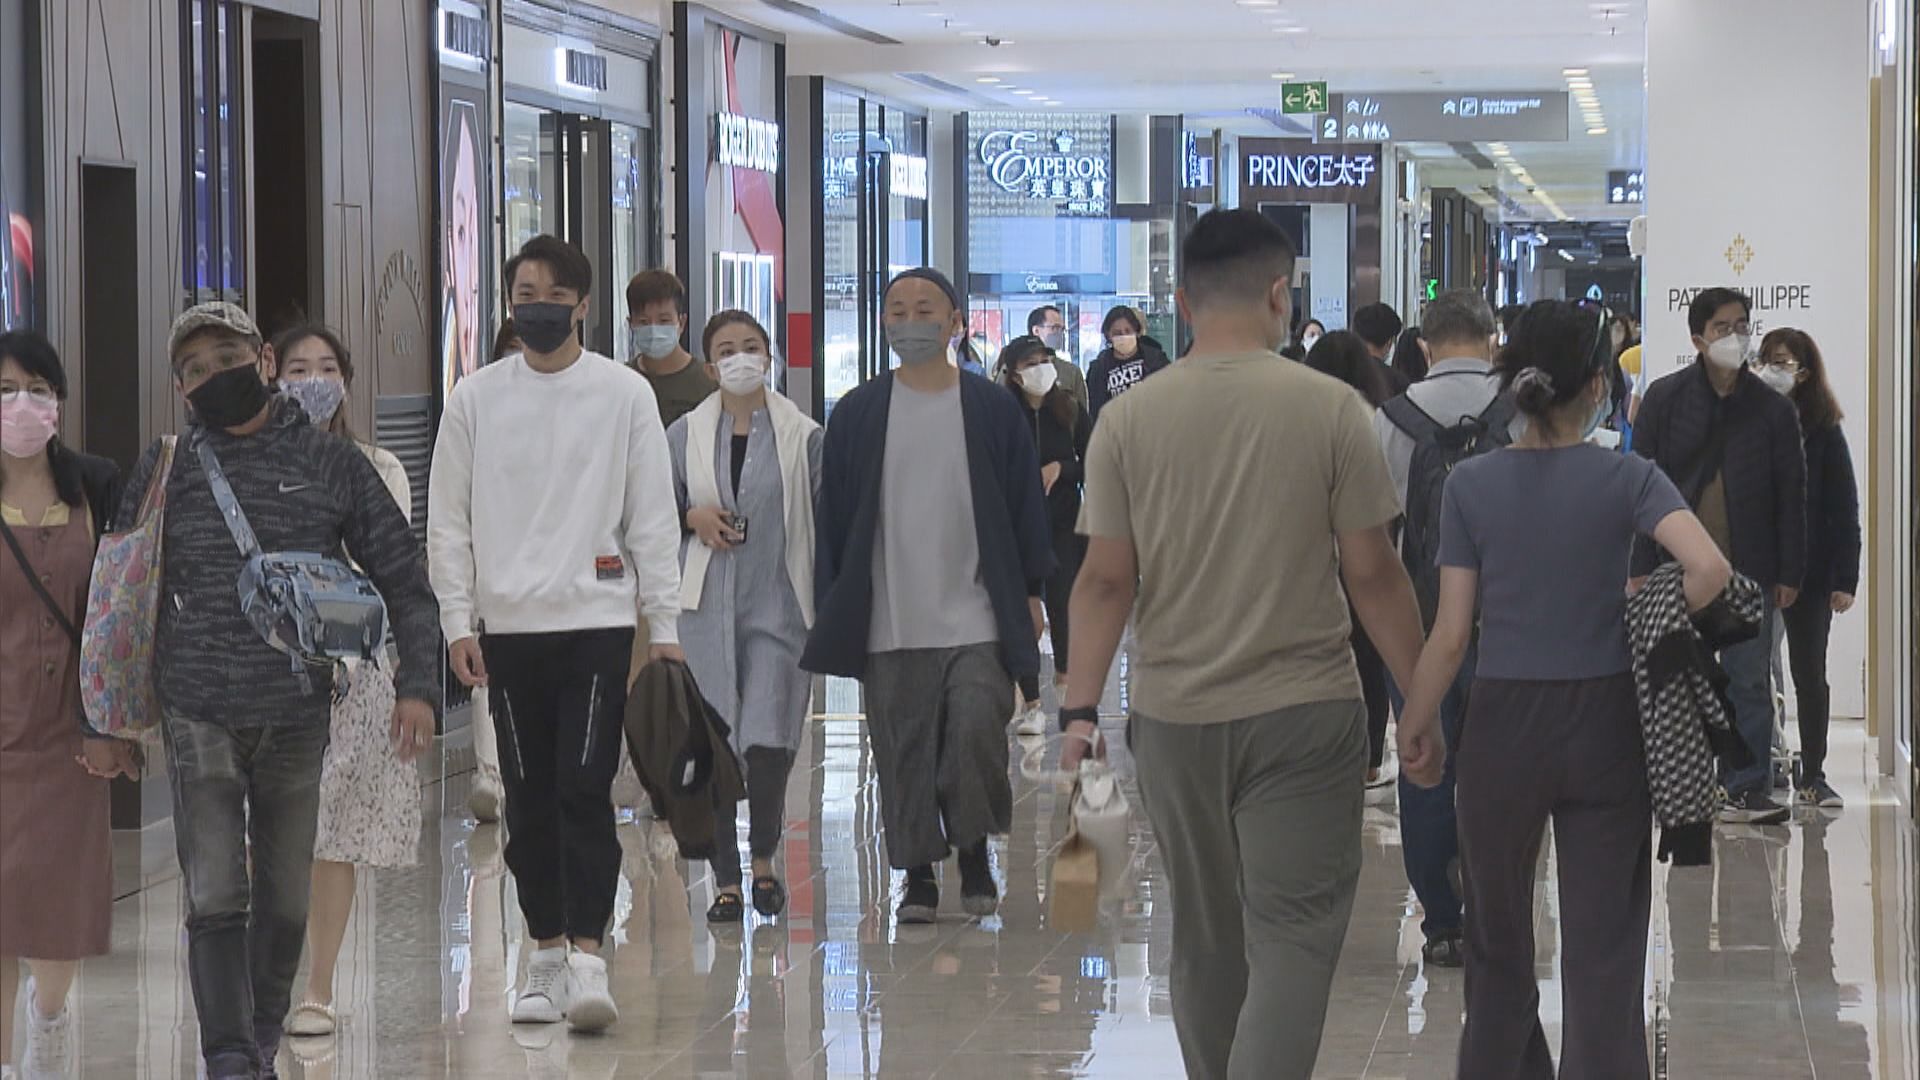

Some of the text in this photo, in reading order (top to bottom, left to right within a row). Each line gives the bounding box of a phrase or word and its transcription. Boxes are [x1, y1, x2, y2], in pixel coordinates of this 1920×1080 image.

[719, 112, 778, 174] ROGER DUBUIS
[1323, 118, 1338, 138] 2
[981, 131, 1106, 192] EMPEROR
